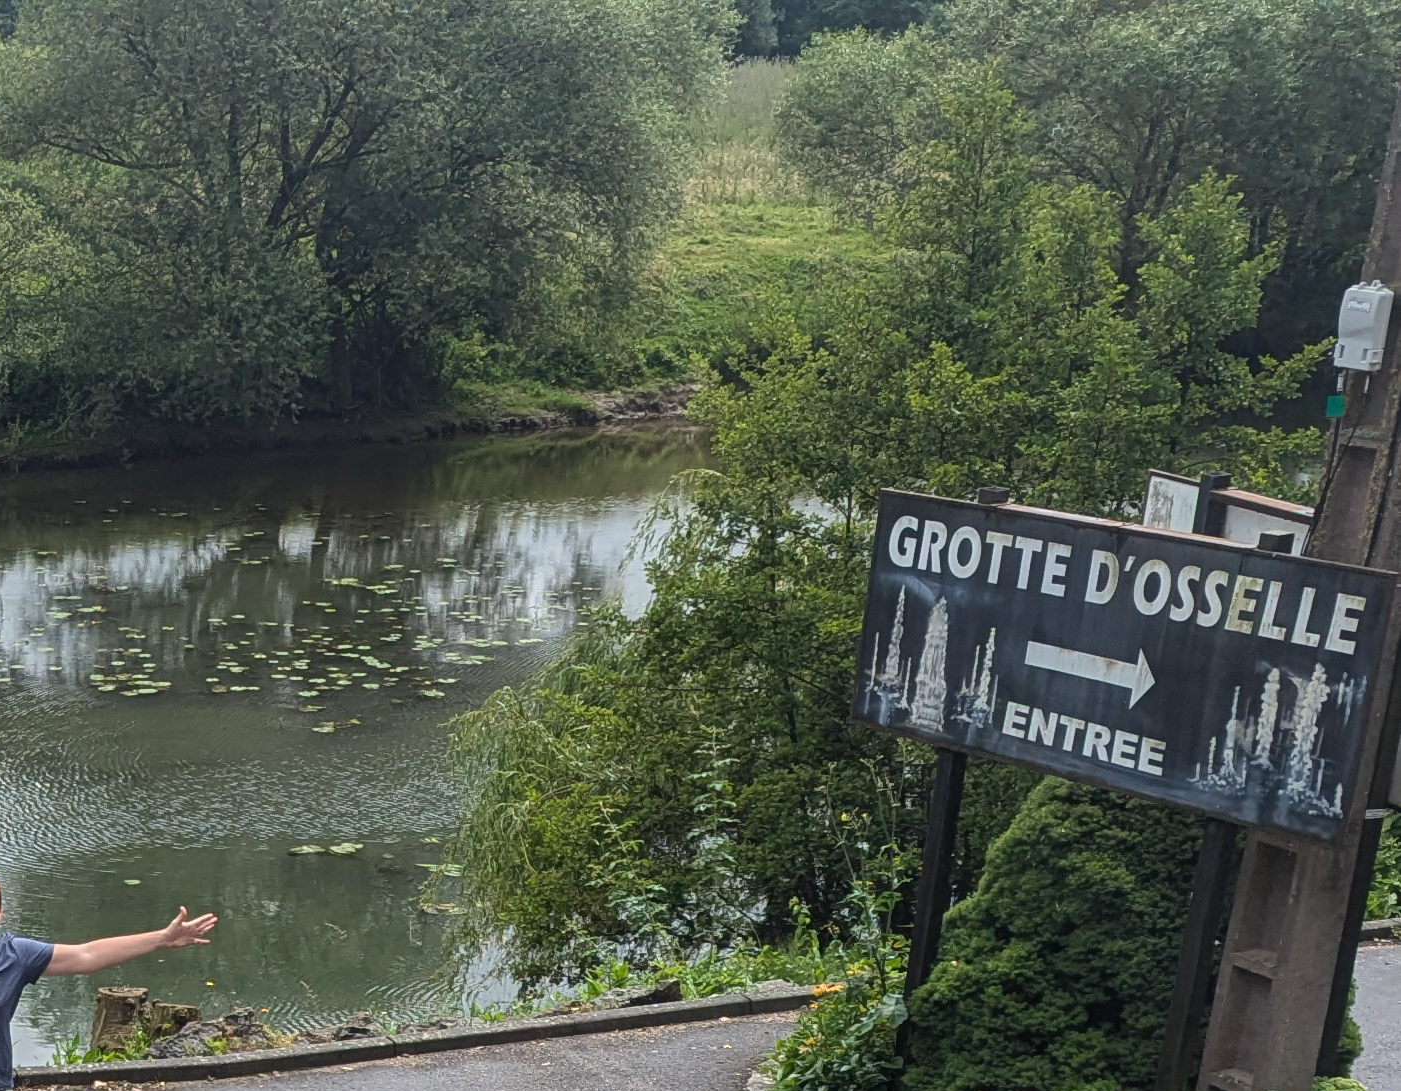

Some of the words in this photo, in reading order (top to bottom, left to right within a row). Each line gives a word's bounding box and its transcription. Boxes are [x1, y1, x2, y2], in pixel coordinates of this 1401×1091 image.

[888, 514, 1072, 598] GROTTE
[1084, 548, 1367, 656] D'OSSELLE
[1001, 701, 1166, 777] ENTREE
